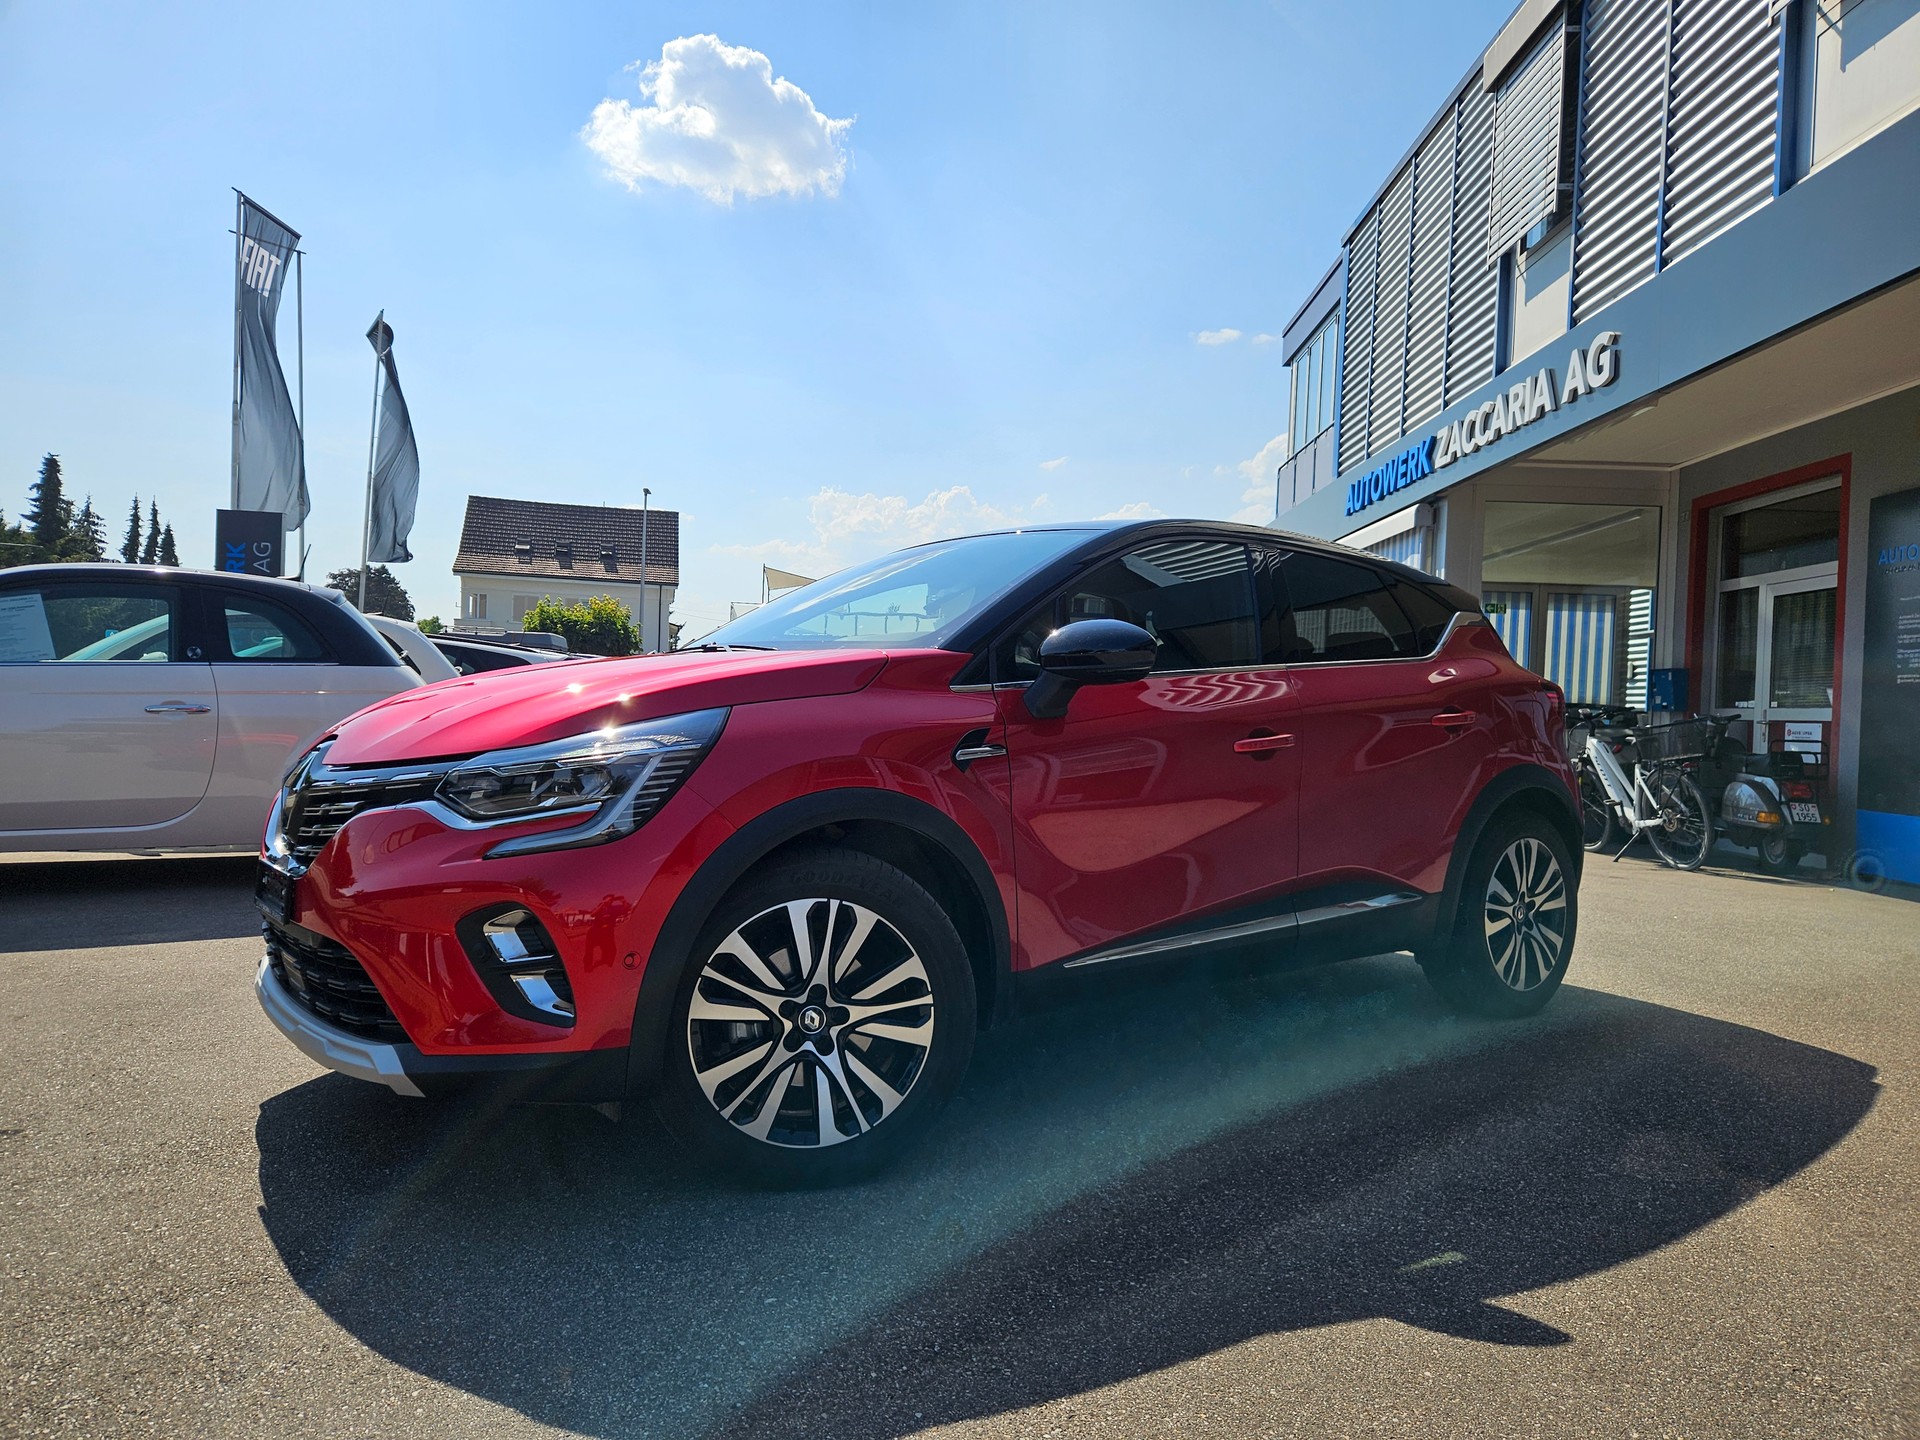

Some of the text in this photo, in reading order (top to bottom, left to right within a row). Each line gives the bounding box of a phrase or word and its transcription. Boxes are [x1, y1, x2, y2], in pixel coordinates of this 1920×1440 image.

[241, 236, 281, 298] FIAT
[1345, 331, 1622, 516] AUTOWERK ZACCARIA AG
[252, 542, 271, 573] AG
[1796, 812, 1818, 822] 1955
